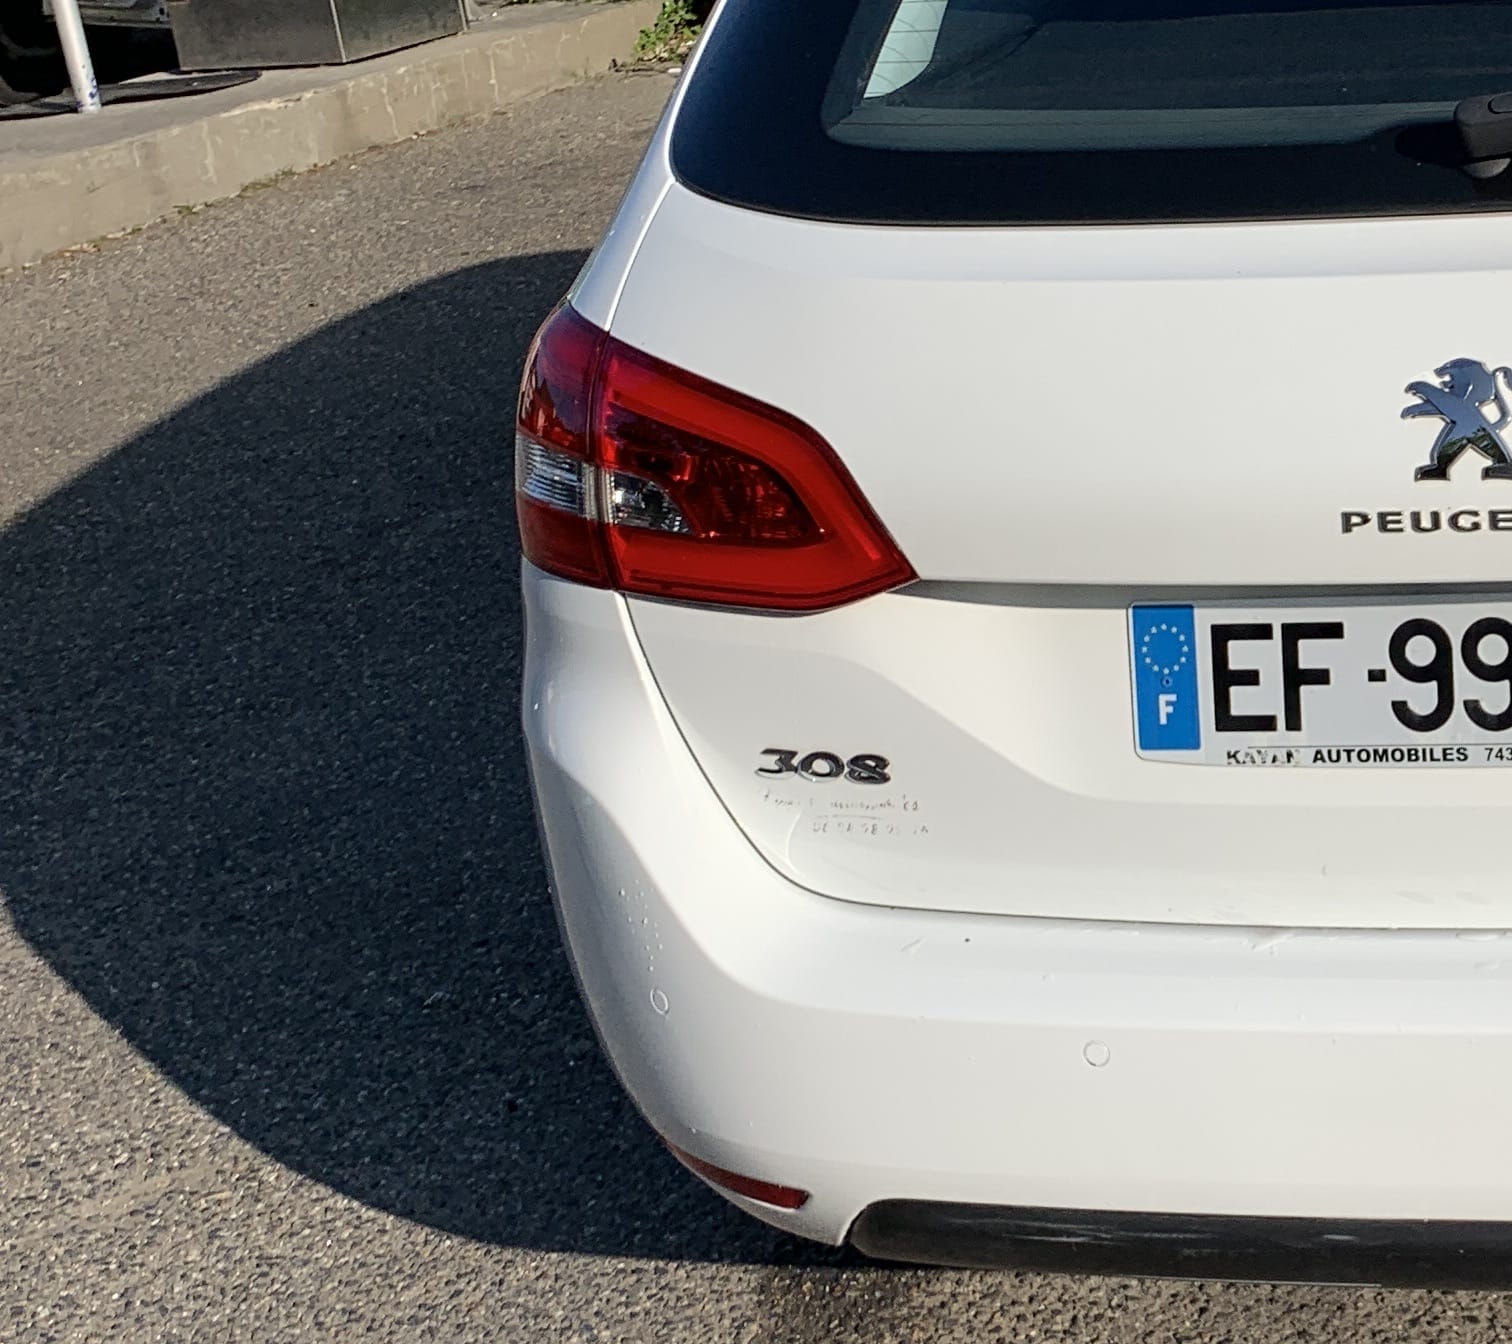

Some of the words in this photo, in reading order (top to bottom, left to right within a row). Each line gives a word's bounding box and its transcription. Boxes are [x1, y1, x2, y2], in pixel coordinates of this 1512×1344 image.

[1158, 693, 1178, 725] F
[754, 747, 892, 785] 308
[1312, 747, 1469, 764] AUTOMOBILES
